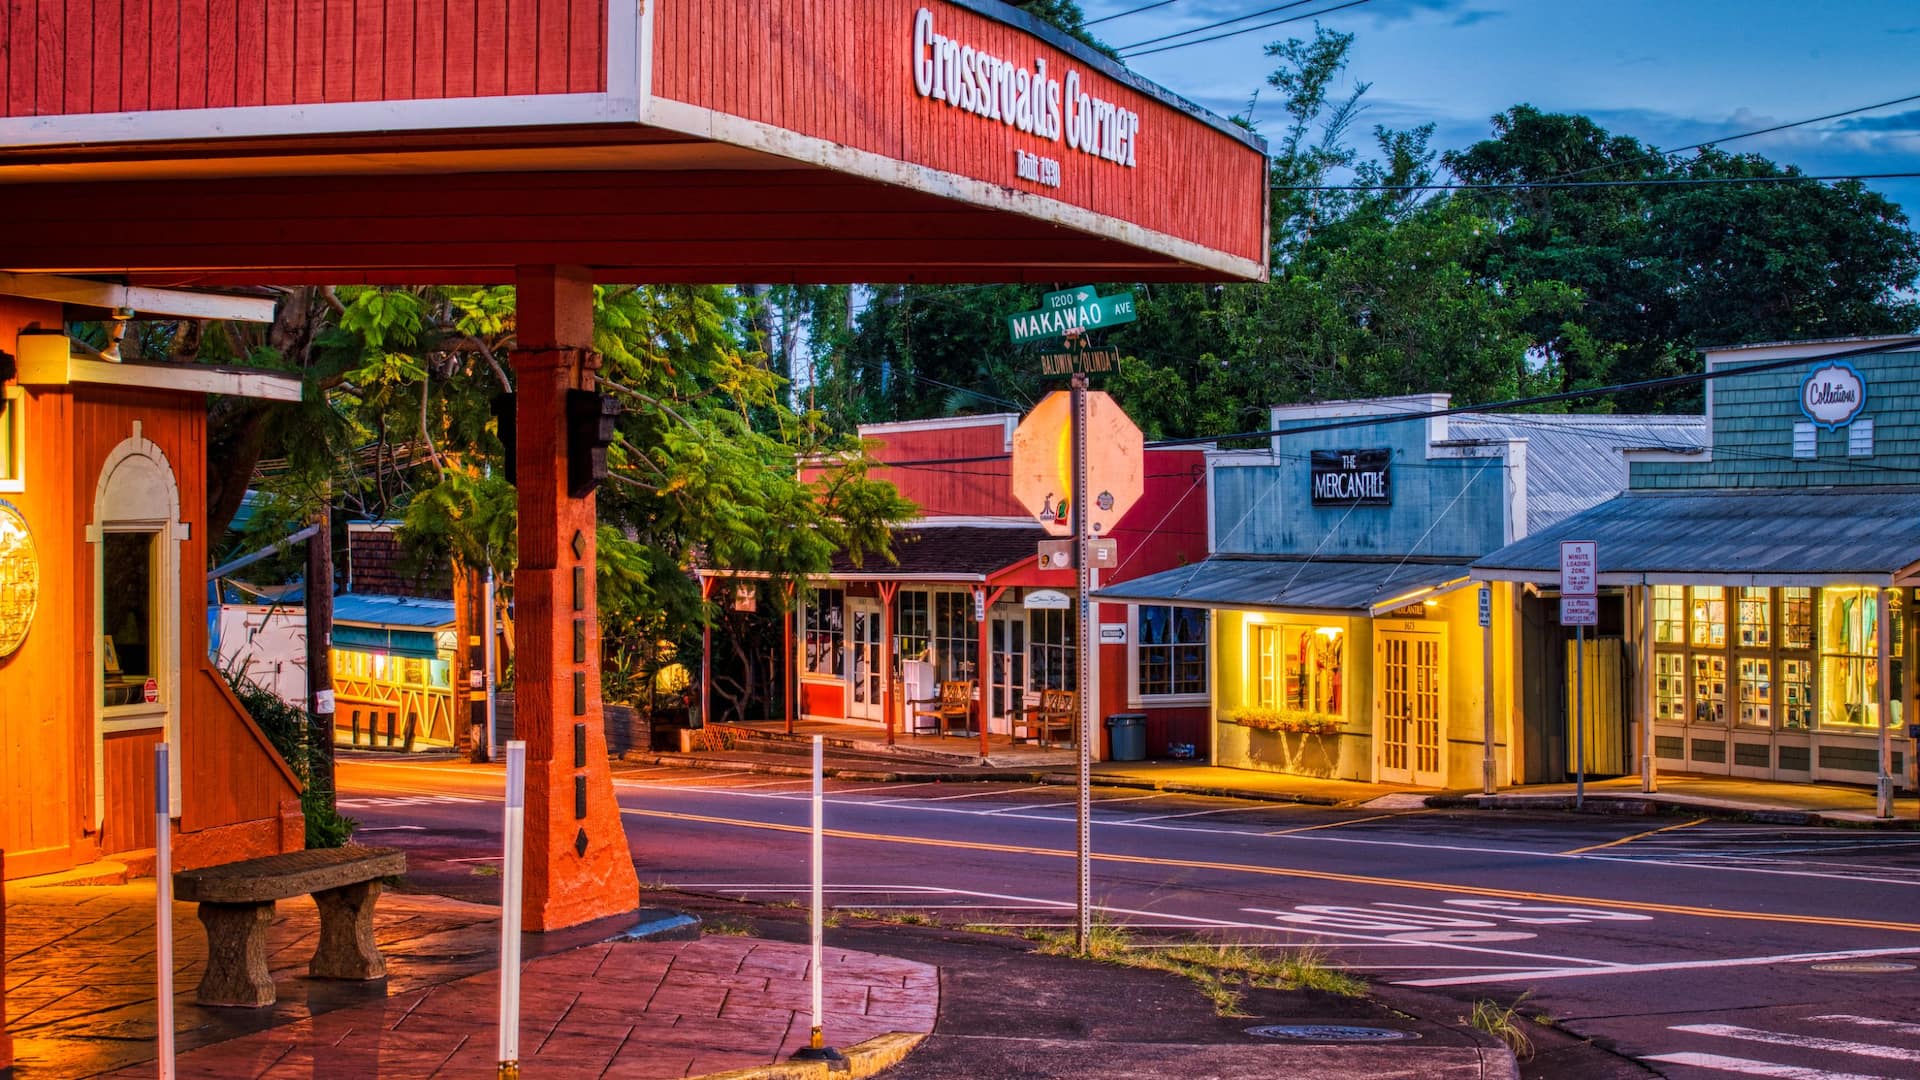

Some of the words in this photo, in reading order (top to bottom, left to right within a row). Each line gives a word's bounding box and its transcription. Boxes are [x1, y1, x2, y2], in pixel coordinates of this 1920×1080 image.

[914, 7, 1061, 143] Crossroads
[1064, 69, 1139, 168] Corner
[1016, 149, 1039, 184] Built
[1039, 155, 1061, 189] 1930
[1051, 293, 1073, 308] 1200
[1012, 303, 1102, 339] MAKAWAO
[1114, 301, 1132, 316] AVE
[1041, 353, 1074, 375] BALDWIN
[1082, 351, 1112, 373] OLINDA
[1810, 382, 1856, 405] Collections
[1342, 455, 1357, 469] THE
[1314, 471, 1385, 499] MERCANTILE
[1238, 899, 1655, 931] STOP
